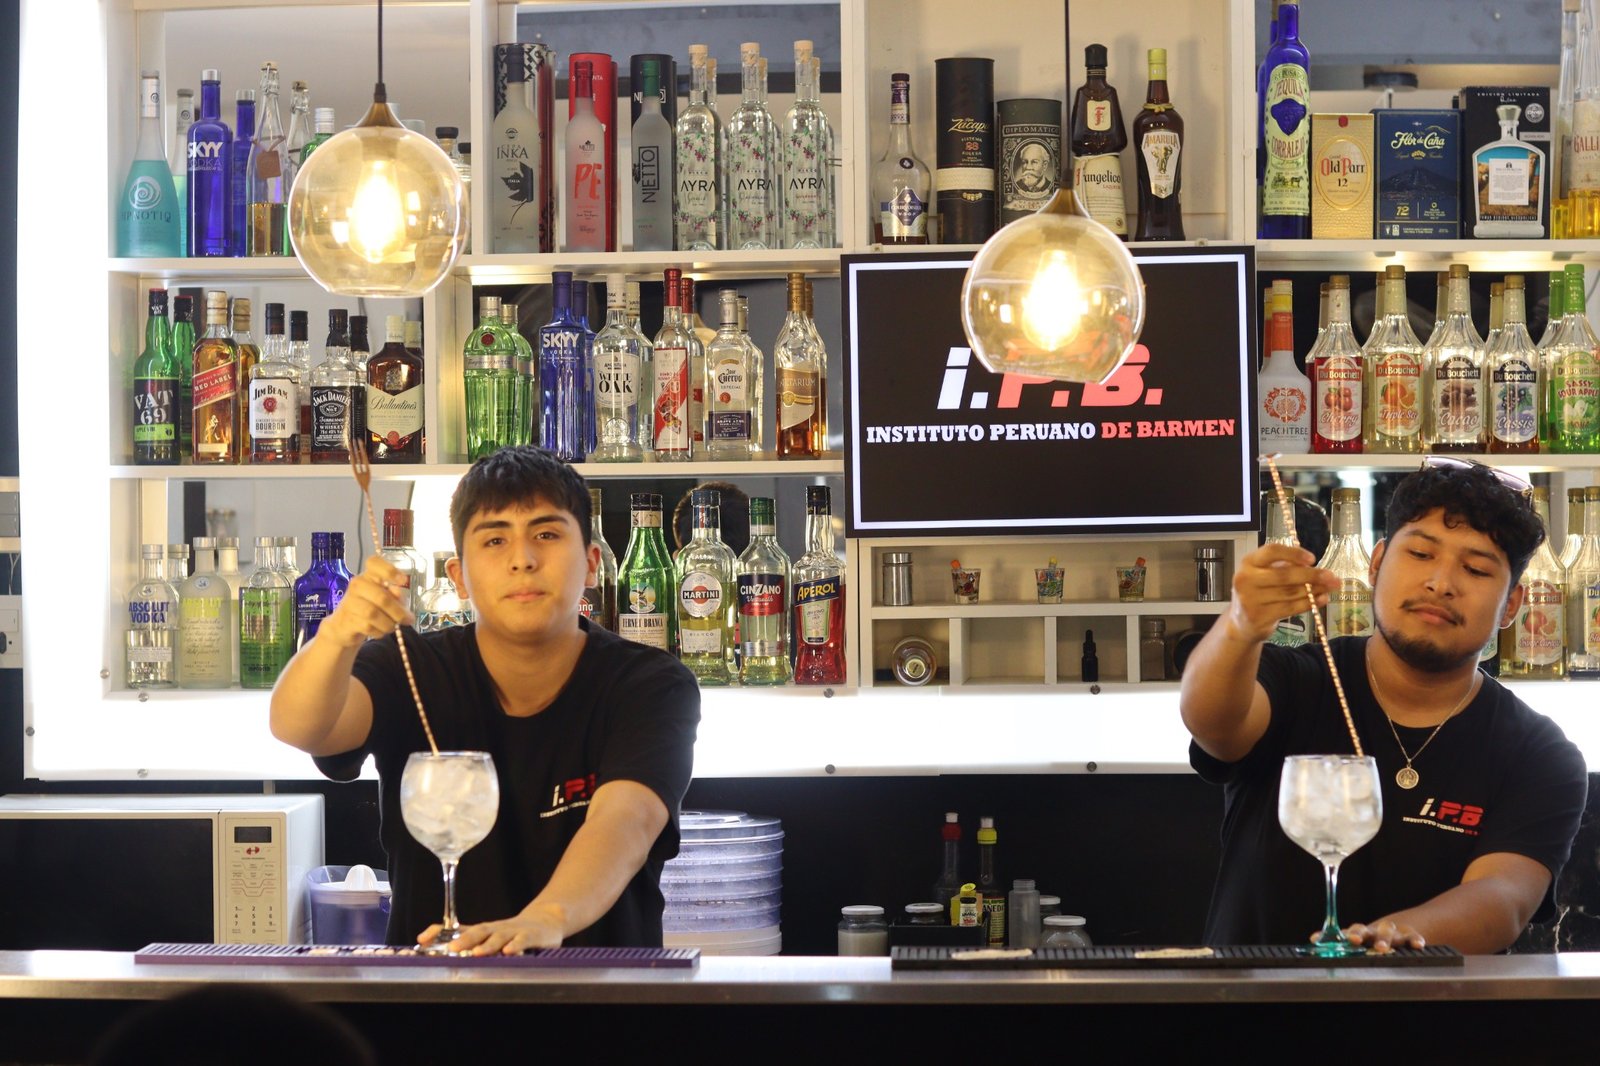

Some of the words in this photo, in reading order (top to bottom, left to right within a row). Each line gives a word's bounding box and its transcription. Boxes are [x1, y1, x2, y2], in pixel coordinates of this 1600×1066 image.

[1144, 134, 1179, 149] AMARULA
[1391, 132, 1416, 149] Flor
[1424, 132, 1445, 149] Caña
[187, 141, 223, 158] SKYY
[497, 147, 528, 159] INKA
[1321, 158, 1340, 176] Old
[1341, 158, 1365, 176] Parr
[641, 149, 656, 203] NIETTO
[1337, 178, 1348, 187] 12
[543, 333, 579, 347] SKYY
[718, 373, 743, 384] Cuervo
[1437, 369, 1447, 377] Du
[1448, 369, 1479, 377] Bouchett
[1494, 373, 1503, 381] Du
[1504, 372, 1535, 381] Bouchett
[194, 382, 208, 391] RED
[210, 374, 232, 386] LABEL
[599, 380, 632, 393] OAK
[1566, 380, 1593, 388] SASSY
[253, 388, 266, 400] JIM
[267, 385, 288, 399] BEAM
[134, 390, 174, 410] VAT
[313, 394, 328, 406] JACK
[140, 407, 167, 425] 69
[1321, 411, 1359, 425] Cherry
[1440, 412, 1479, 426] Cacao
[1497, 416, 1534, 429] Cassis
[256, 422, 286, 430] BOURBON
[866, 424, 985, 443] INSTITUTO
[989, 422, 1096, 441] PERUANO
[1101, 421, 1132, 439] DE
[1137, 419, 1235, 438] BARMEN
[1261, 427, 1309, 435] PEACHTREE
[684, 590, 719, 599] MARTINI
[740, 584, 781, 596] CINZANO
[797, 583, 836, 601] APEROL
[128, 602, 170, 612] ABSOLUT
[130, 612, 165, 624] VODKA
[643, 618, 663, 628] BRANCA
